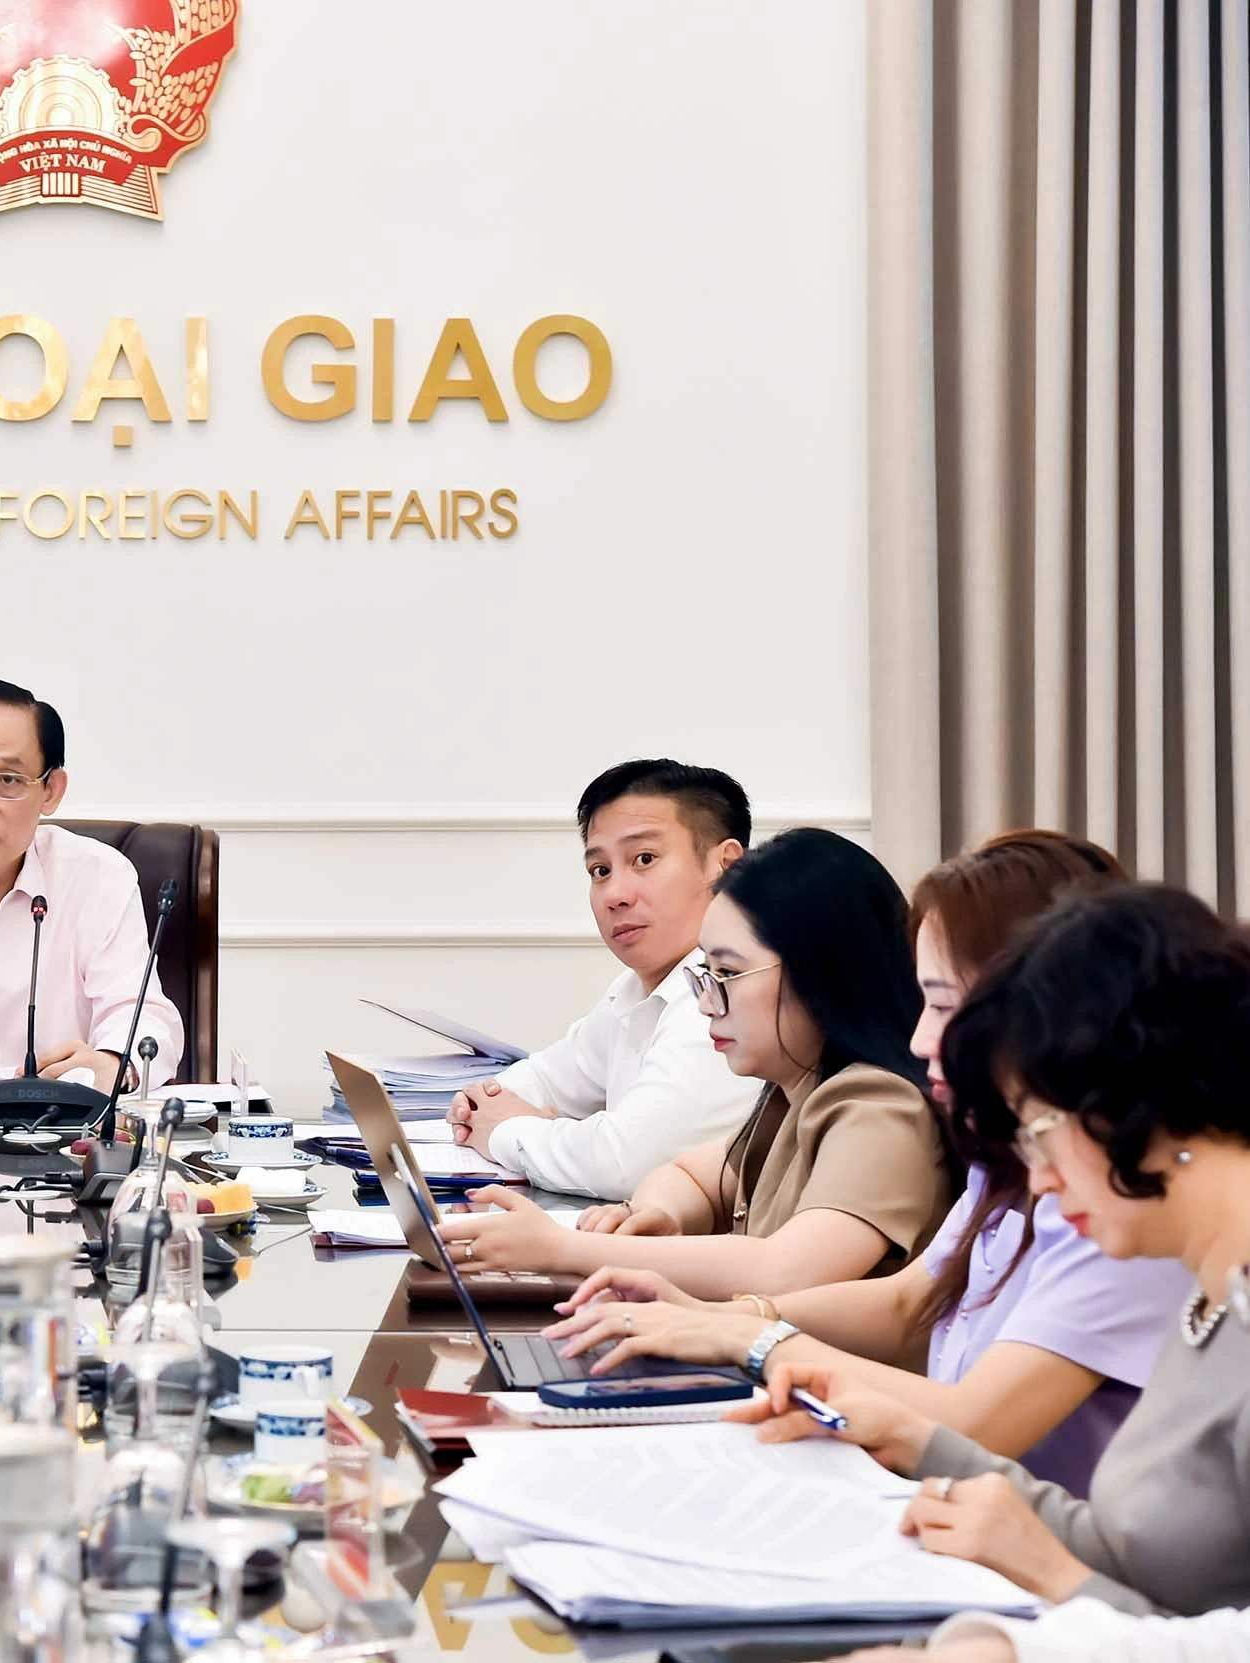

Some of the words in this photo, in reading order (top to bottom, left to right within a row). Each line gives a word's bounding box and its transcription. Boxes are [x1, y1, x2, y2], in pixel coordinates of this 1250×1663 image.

[43, 137, 59, 149] XÃ
[19, 152, 62, 172] VIỆT
[65, 153, 107, 173] NAM
[260, 314, 614, 424] GIAO
[285, 488, 520, 541] AFFAIRS
